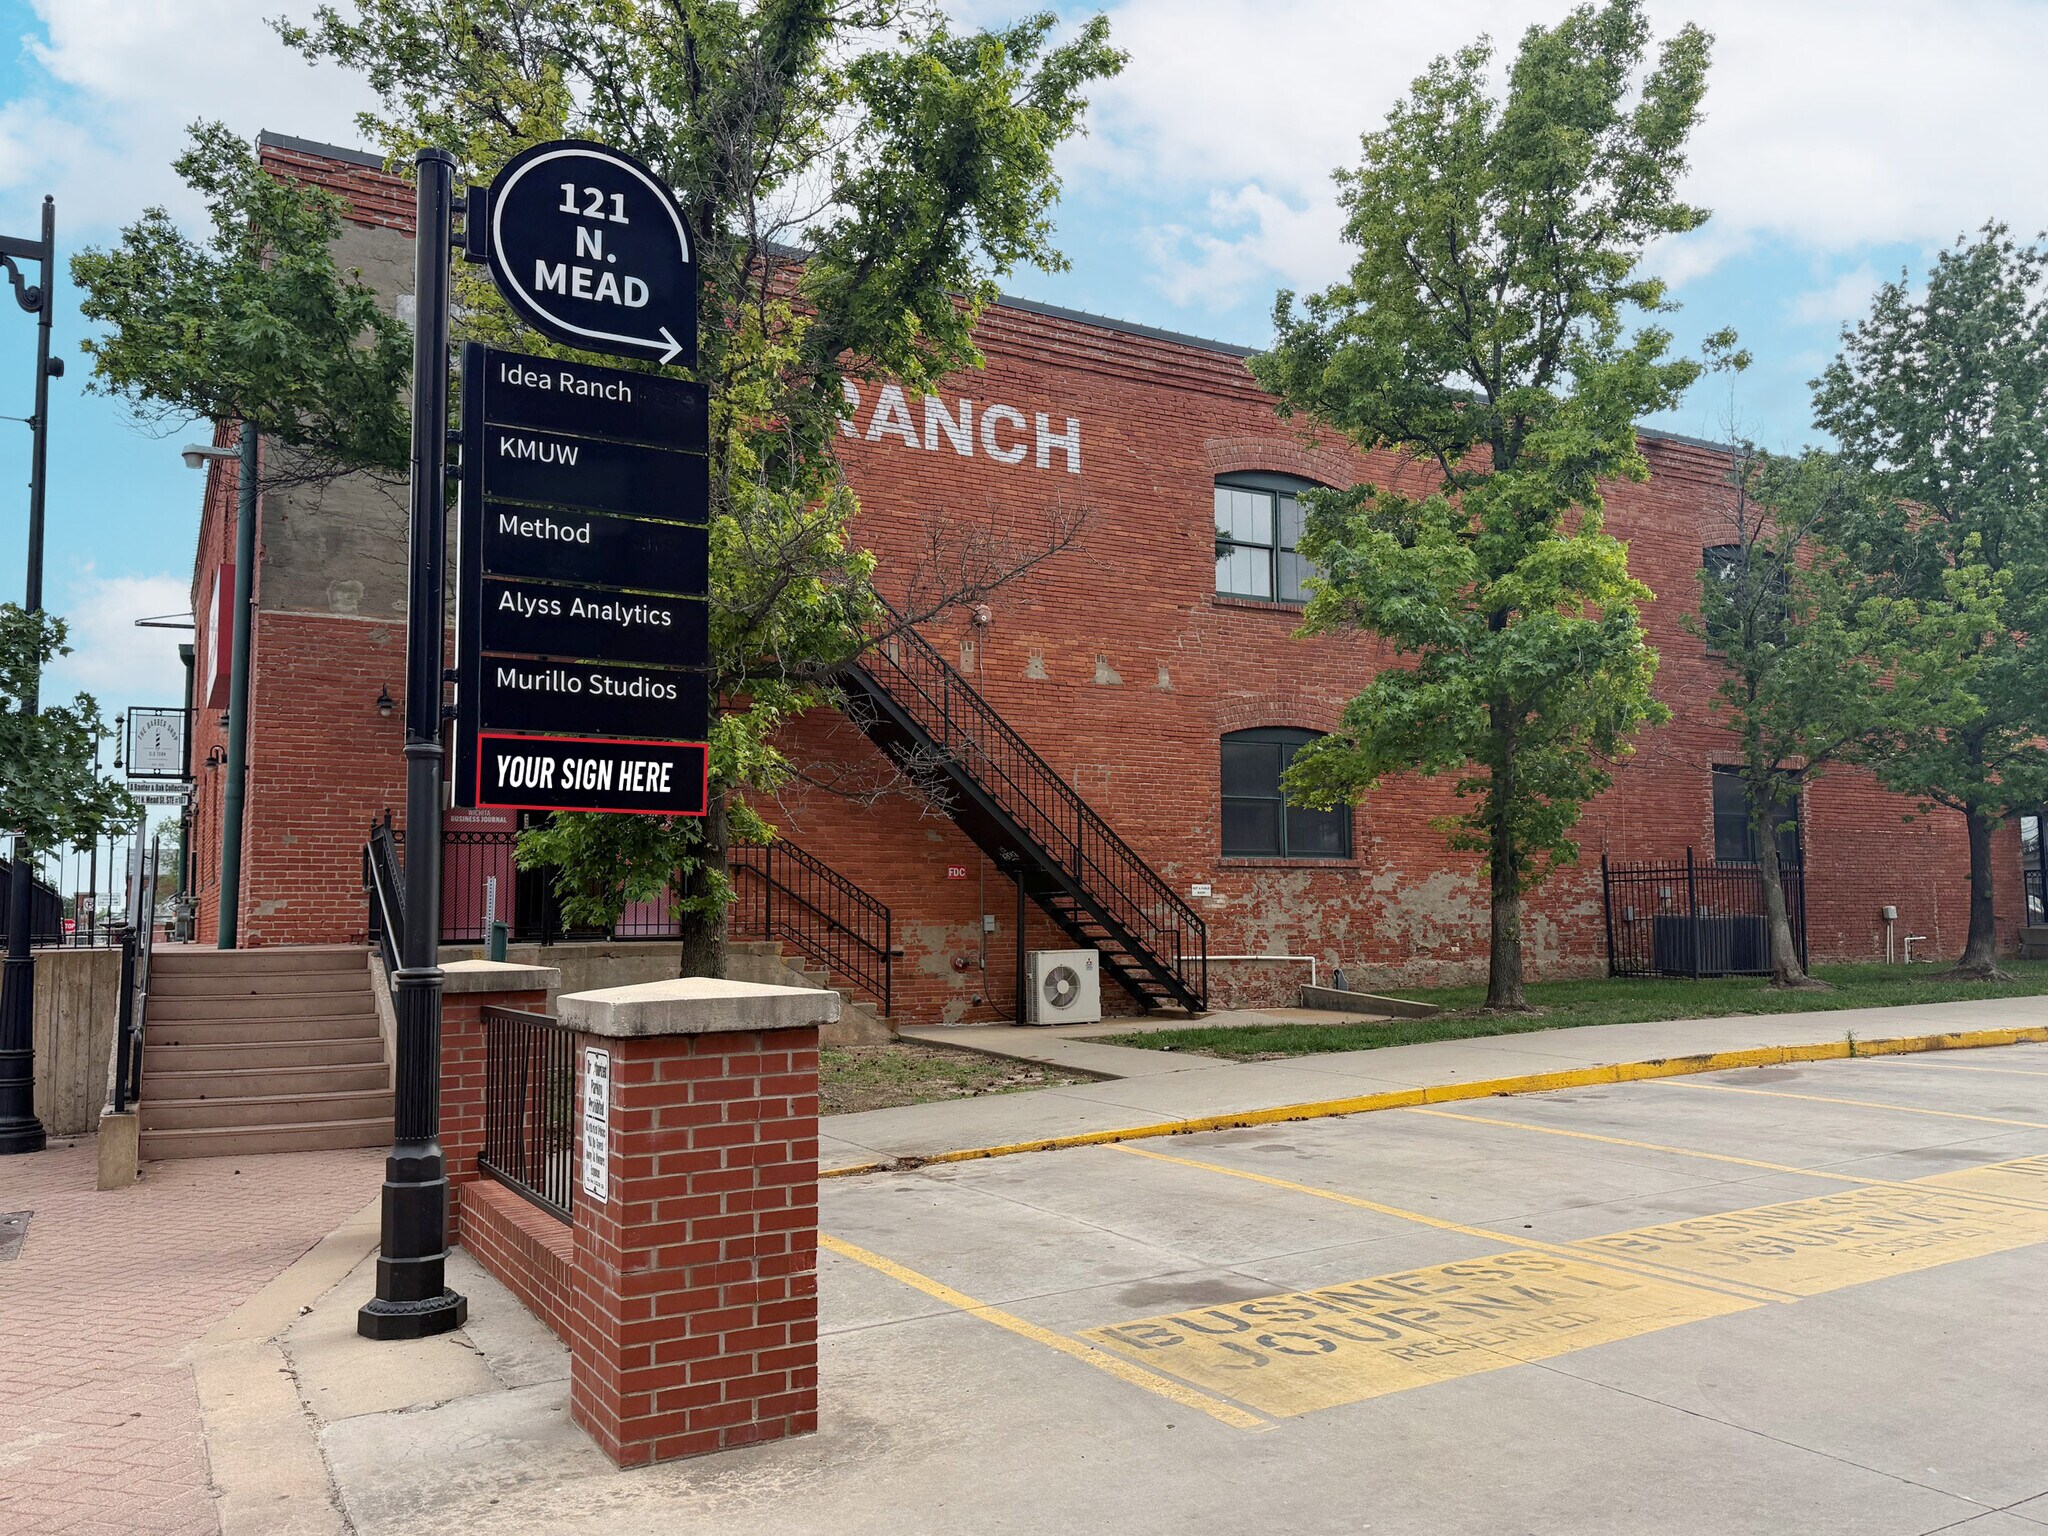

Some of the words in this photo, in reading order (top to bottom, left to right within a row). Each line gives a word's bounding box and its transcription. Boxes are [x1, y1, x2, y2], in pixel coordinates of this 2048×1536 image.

[560, 183, 629, 224] 121
[576, 226, 617, 264] N.
[535, 259, 650, 308] MEAD
[501, 363, 551, 389] Idea
[560, 373, 632, 402] Ranch
[500, 435, 579, 466] KMUW
[499, 513, 590, 544] Method
[499, 590, 561, 618] Alyss
[570, 598, 672, 627] Analytics
[497, 667, 582, 693] Murillo
[589, 674, 677, 699] Studios
[147, 719, 166, 729] BARBER
[167, 725, 178, 741] SHOP
[165, 784, 188, 792] Collective
[497, 754, 556, 788] YOUR
[560, 757, 614, 791] SIGN
[618, 760, 674, 793] HERE
[147, 796, 158, 804] Mead
[949, 868, 965, 877] FDC
[1099, 1254, 1566, 1350] BUSINESS
[1213, 1275, 1642, 1369] JOURNAL
[1382, 1311, 1600, 1362] RESERVED
